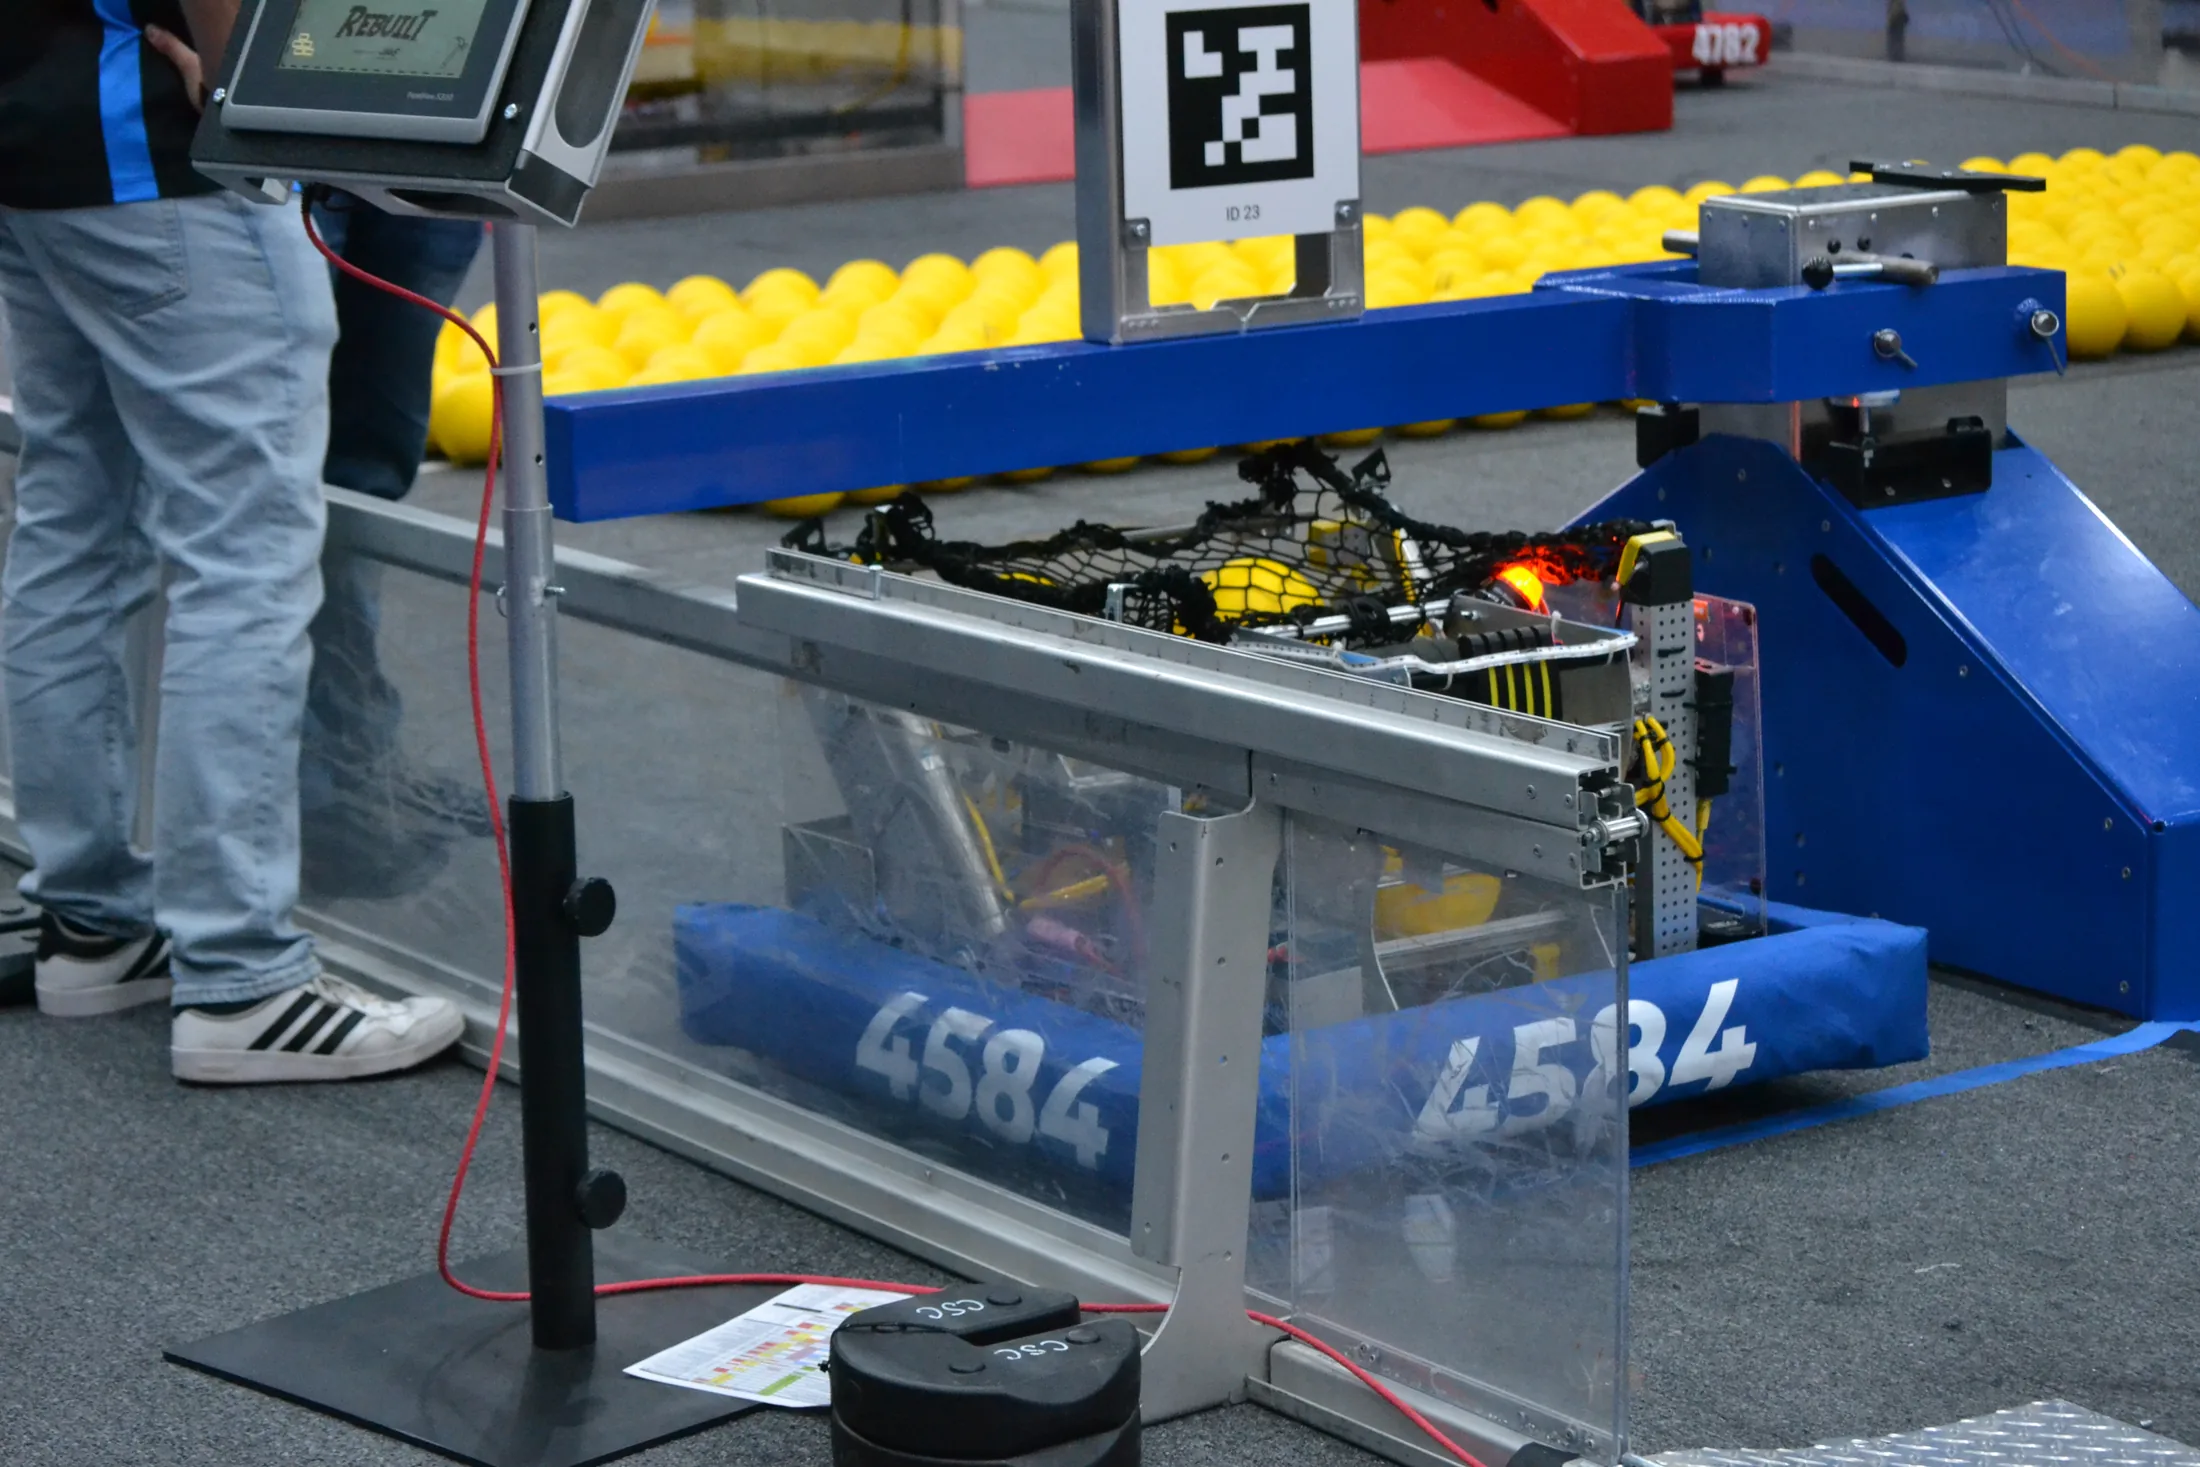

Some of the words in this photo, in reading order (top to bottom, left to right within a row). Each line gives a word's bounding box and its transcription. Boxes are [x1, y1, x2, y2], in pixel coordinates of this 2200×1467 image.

[334, 5, 438, 41] REBUILT
[1692, 23, 1760, 65] 4782
[1226, 206, 1240, 221] ID
[1244, 204, 1261, 220] 23
[856, 991, 1120, 1170] 4584
[1412, 978, 1757, 1141] 4584
